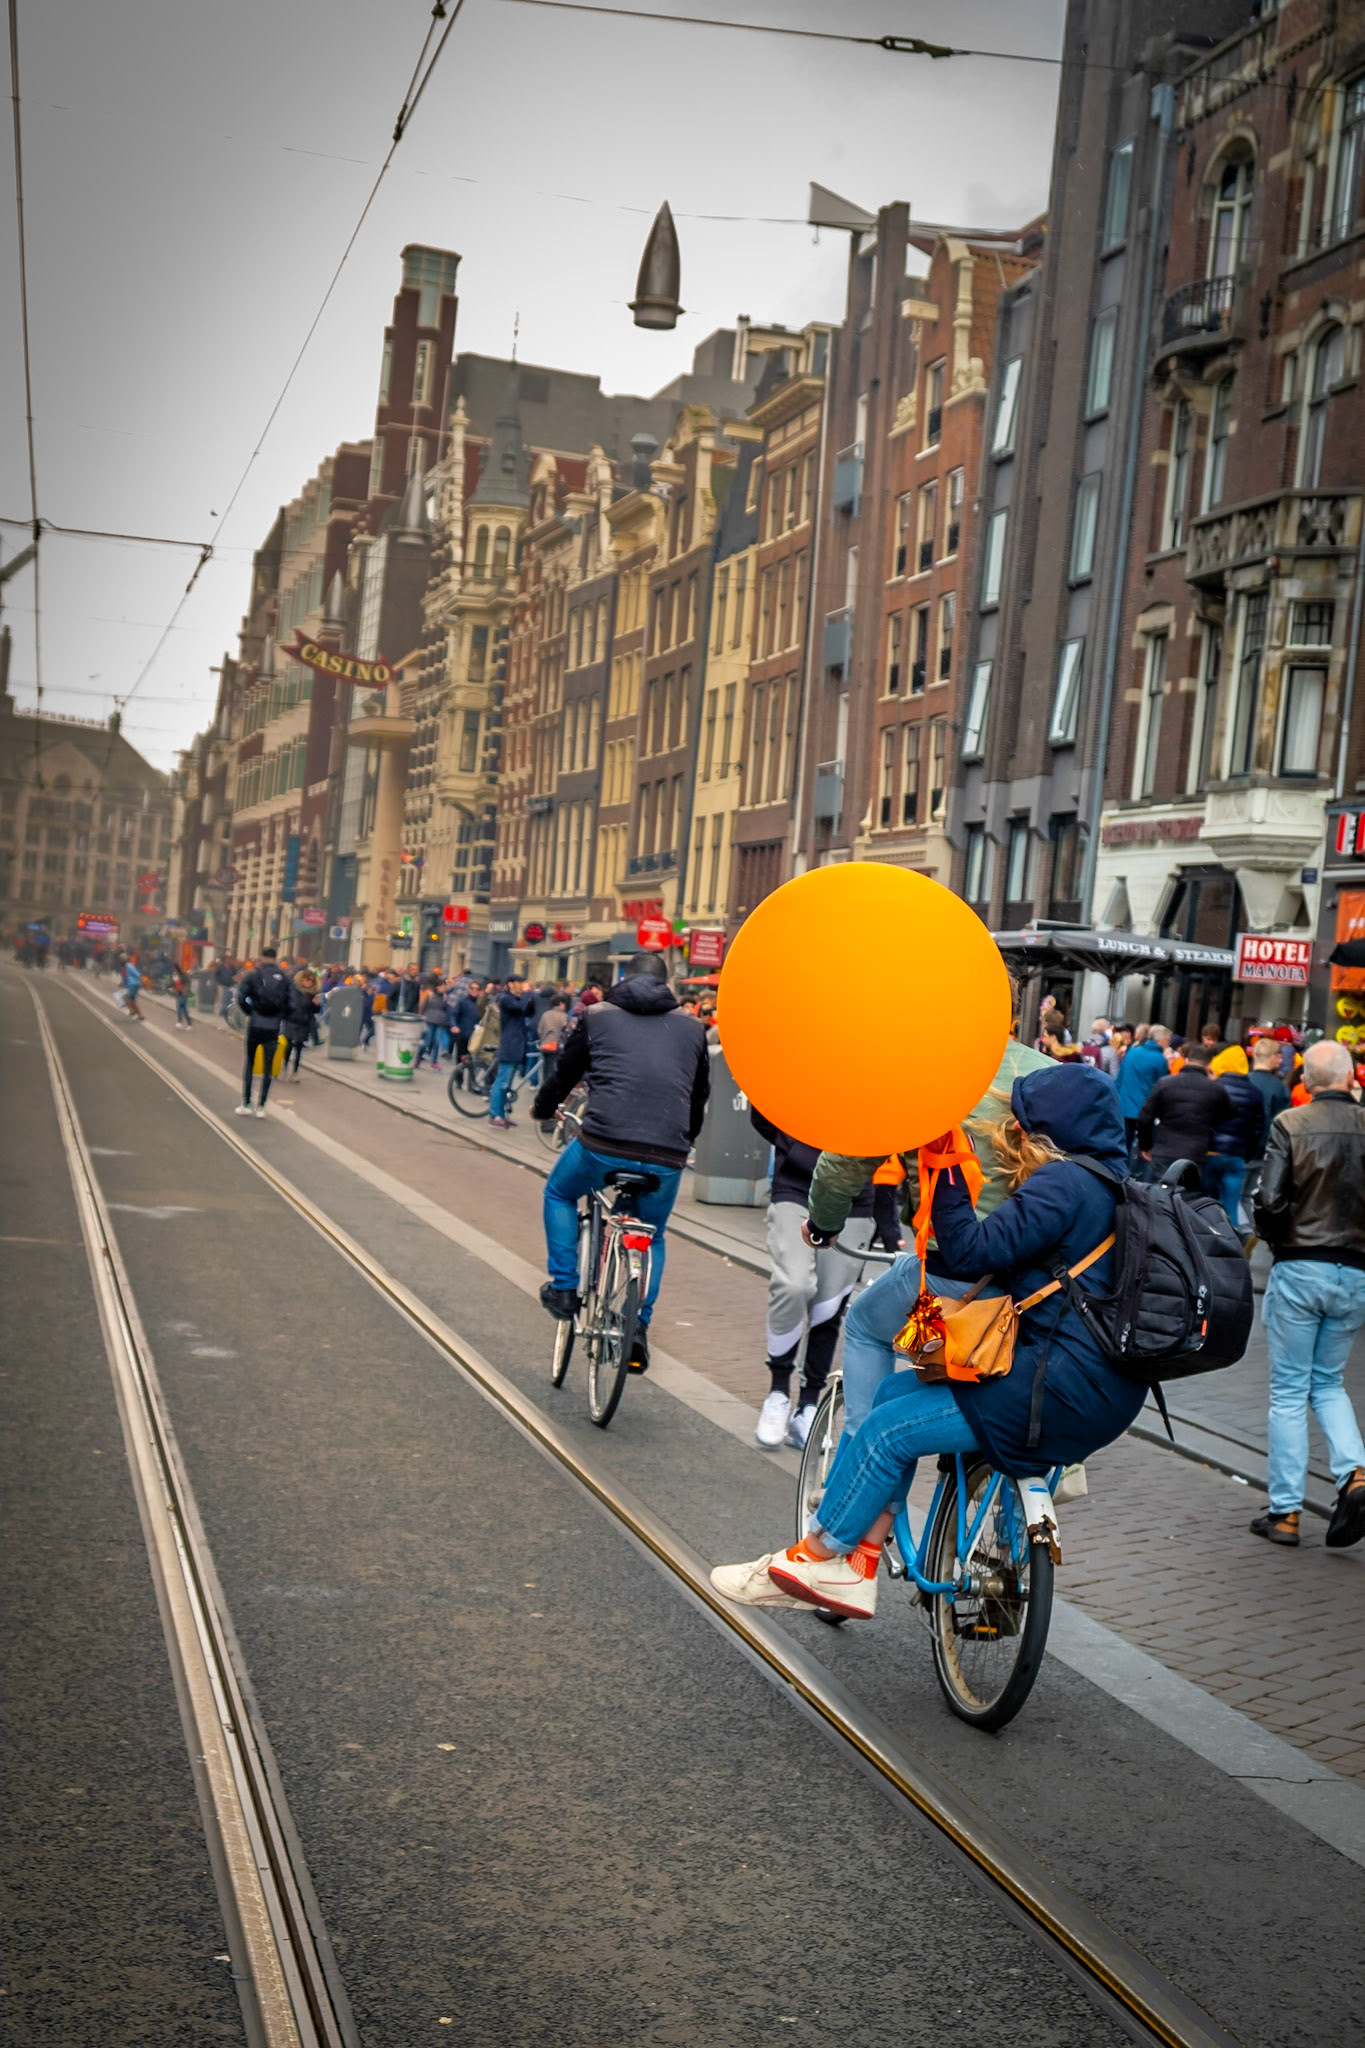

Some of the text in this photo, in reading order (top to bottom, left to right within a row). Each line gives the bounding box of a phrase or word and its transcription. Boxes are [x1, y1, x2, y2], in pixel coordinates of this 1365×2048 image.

[300, 643, 390, 682] CASINO
[1097, 937, 1151, 954] LUNCH
[1153, 946, 1166, 957] &
[1244, 939, 1309, 963] HOTEL
[1242, 961, 1307, 982] MANOFA
